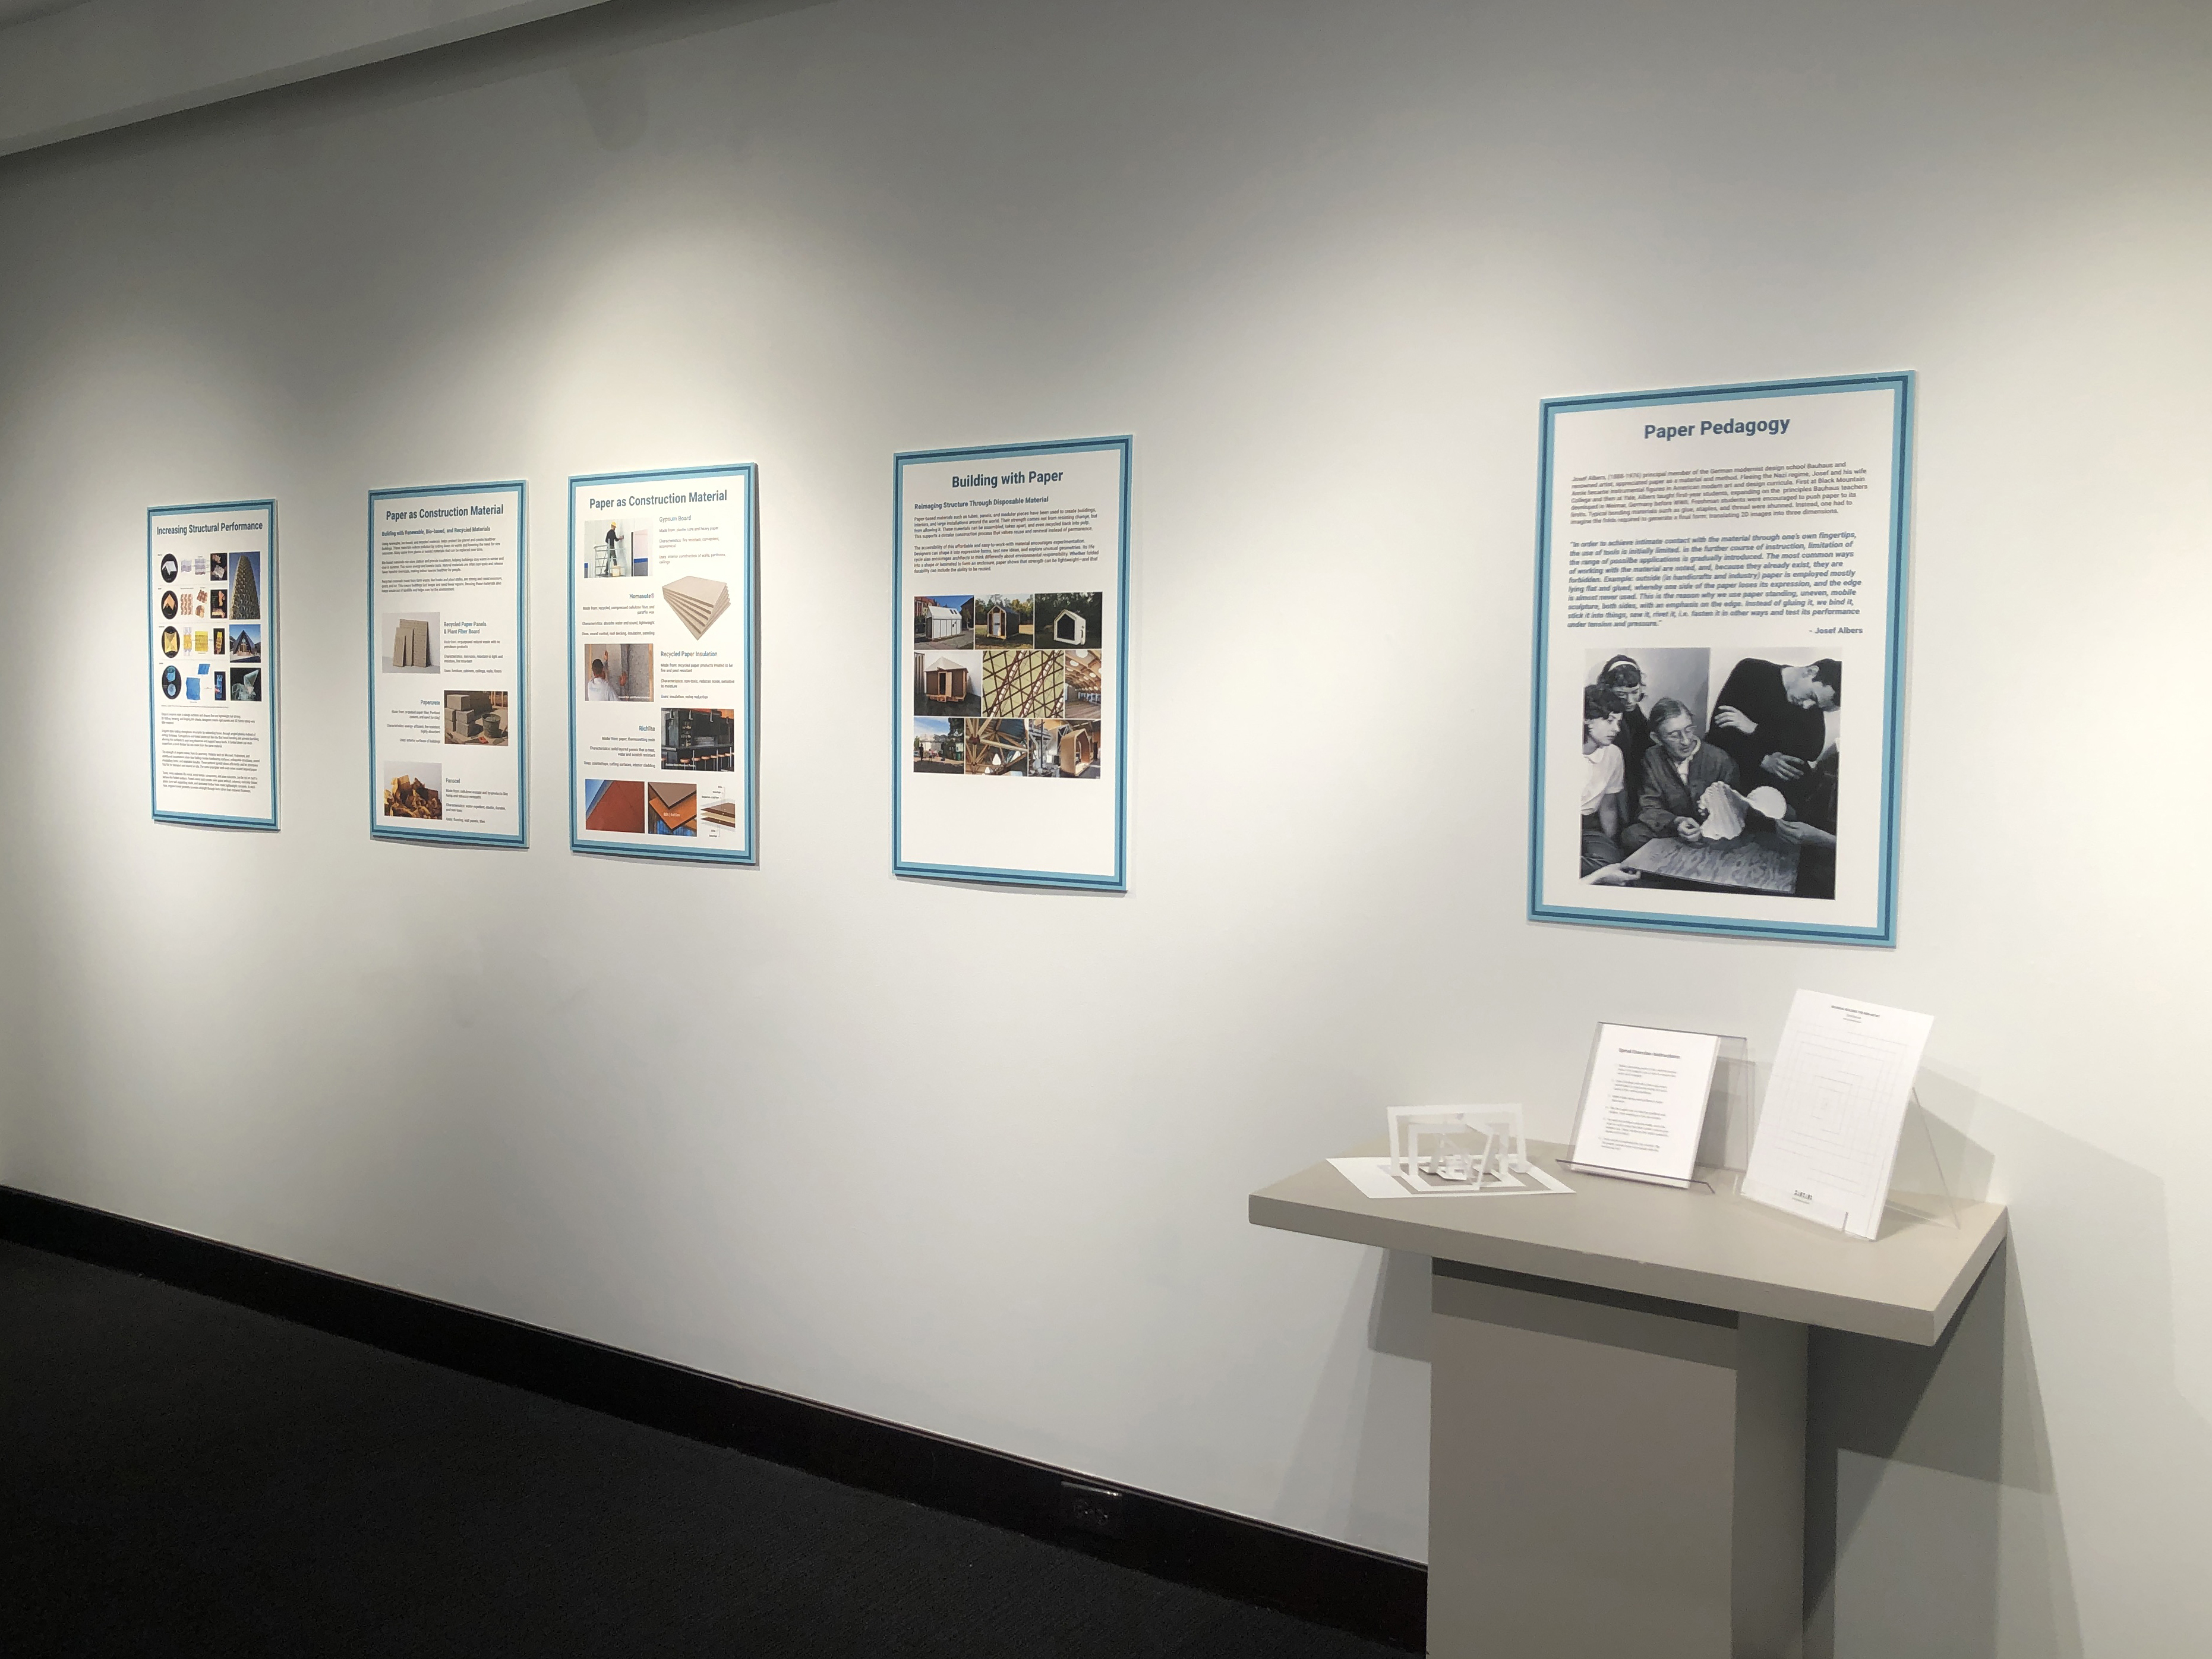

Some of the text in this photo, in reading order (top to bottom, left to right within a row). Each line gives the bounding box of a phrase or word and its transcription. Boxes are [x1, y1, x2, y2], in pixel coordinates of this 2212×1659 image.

[1644, 418, 1790, 441] Paper Pedagogy
[952, 471, 1063, 488] Building with Paper
[589, 489, 727, 510] Paper as Construction Material
[969, 499, 992, 507] Through
[993, 497, 1024, 506] Disposable
[386, 510, 407, 522] Paper
[419, 506, 468, 518] Construction
[470, 503, 503, 515] Material
[157, 521, 263, 535] Increasing Structural Performance
[1752, 534, 1780, 542] through
[1818, 531, 1856, 540] fingertips,
[1812, 607, 1860, 616] performance
